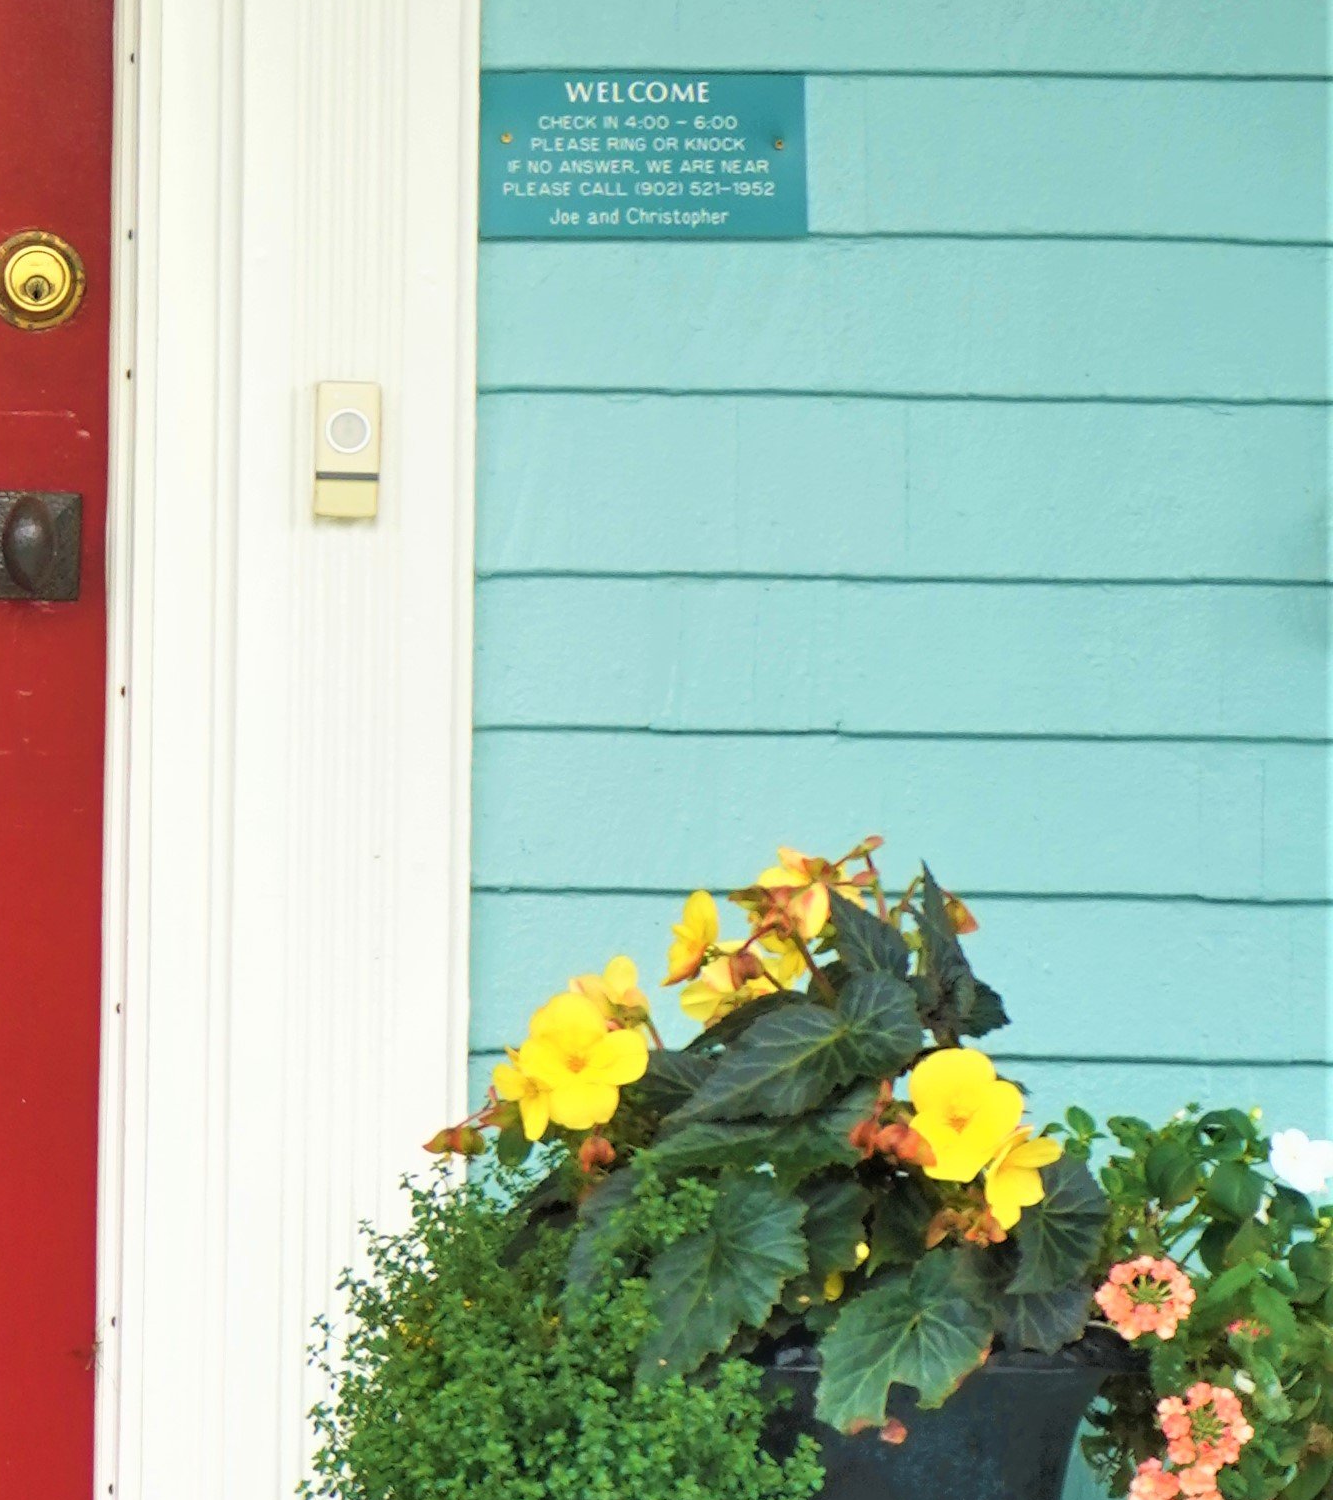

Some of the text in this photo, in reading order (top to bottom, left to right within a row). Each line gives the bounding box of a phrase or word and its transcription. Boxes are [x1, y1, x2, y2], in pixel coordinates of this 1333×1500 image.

[564, 81, 710, 103] WELCOME
[538, 115, 597, 130] CHECK
[603, 115, 619, 130] IN
[624, 115, 670, 130] 4:00
[694, 115, 738, 130] 6:00
[531, 137, 746, 151] PLEASE RING OR KNOCK
[508, 160, 522, 173] IF
[527, 160, 553, 174] NO
[646, 159, 673, 174] WE
[679, 159, 716, 174] ARE
[721, 159, 770, 174] NEAR
[503, 181, 775, 197] PLEASE CALL (902) 521-1952
[550, 207, 730, 229] Joe and Christopher
